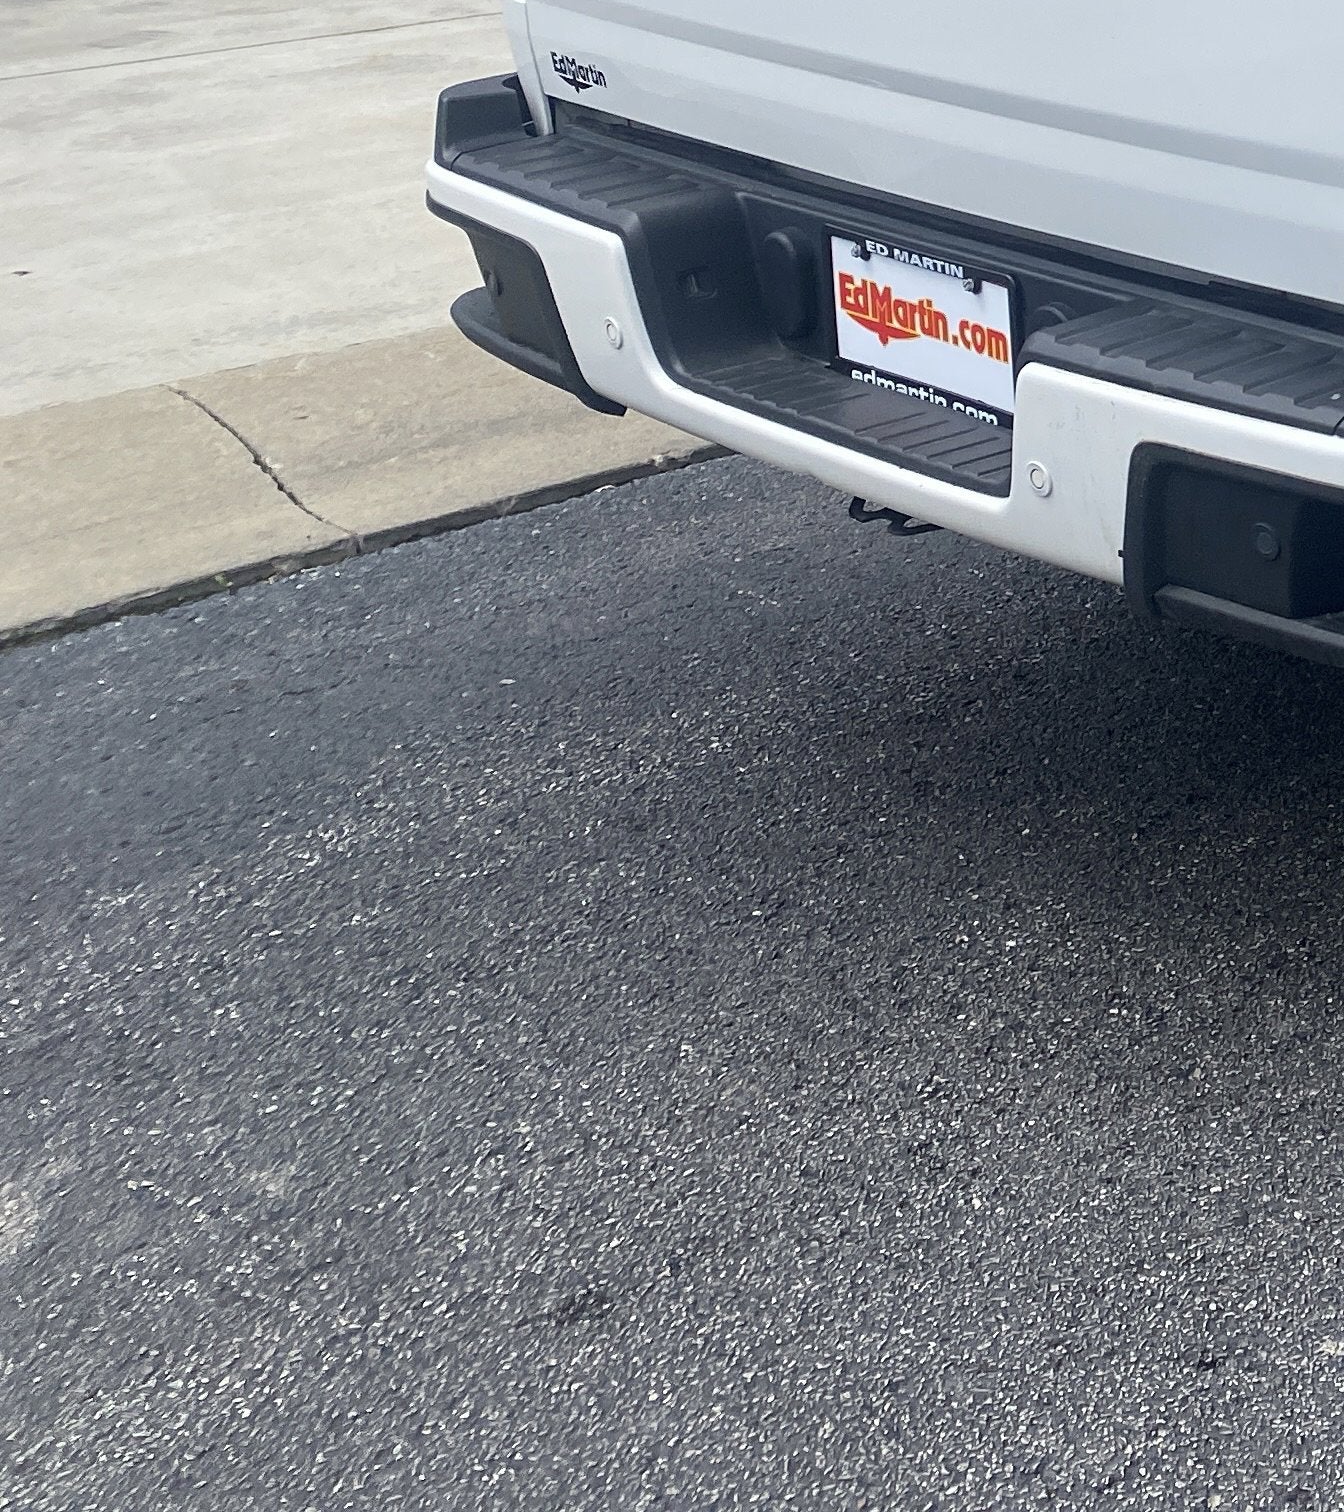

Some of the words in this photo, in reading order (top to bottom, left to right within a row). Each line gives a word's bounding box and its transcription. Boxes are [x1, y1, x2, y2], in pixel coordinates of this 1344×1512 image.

[550, 50, 608, 89] EdMartin
[865, 239, 889, 257] ED
[893, 248, 964, 279] MARTIN
